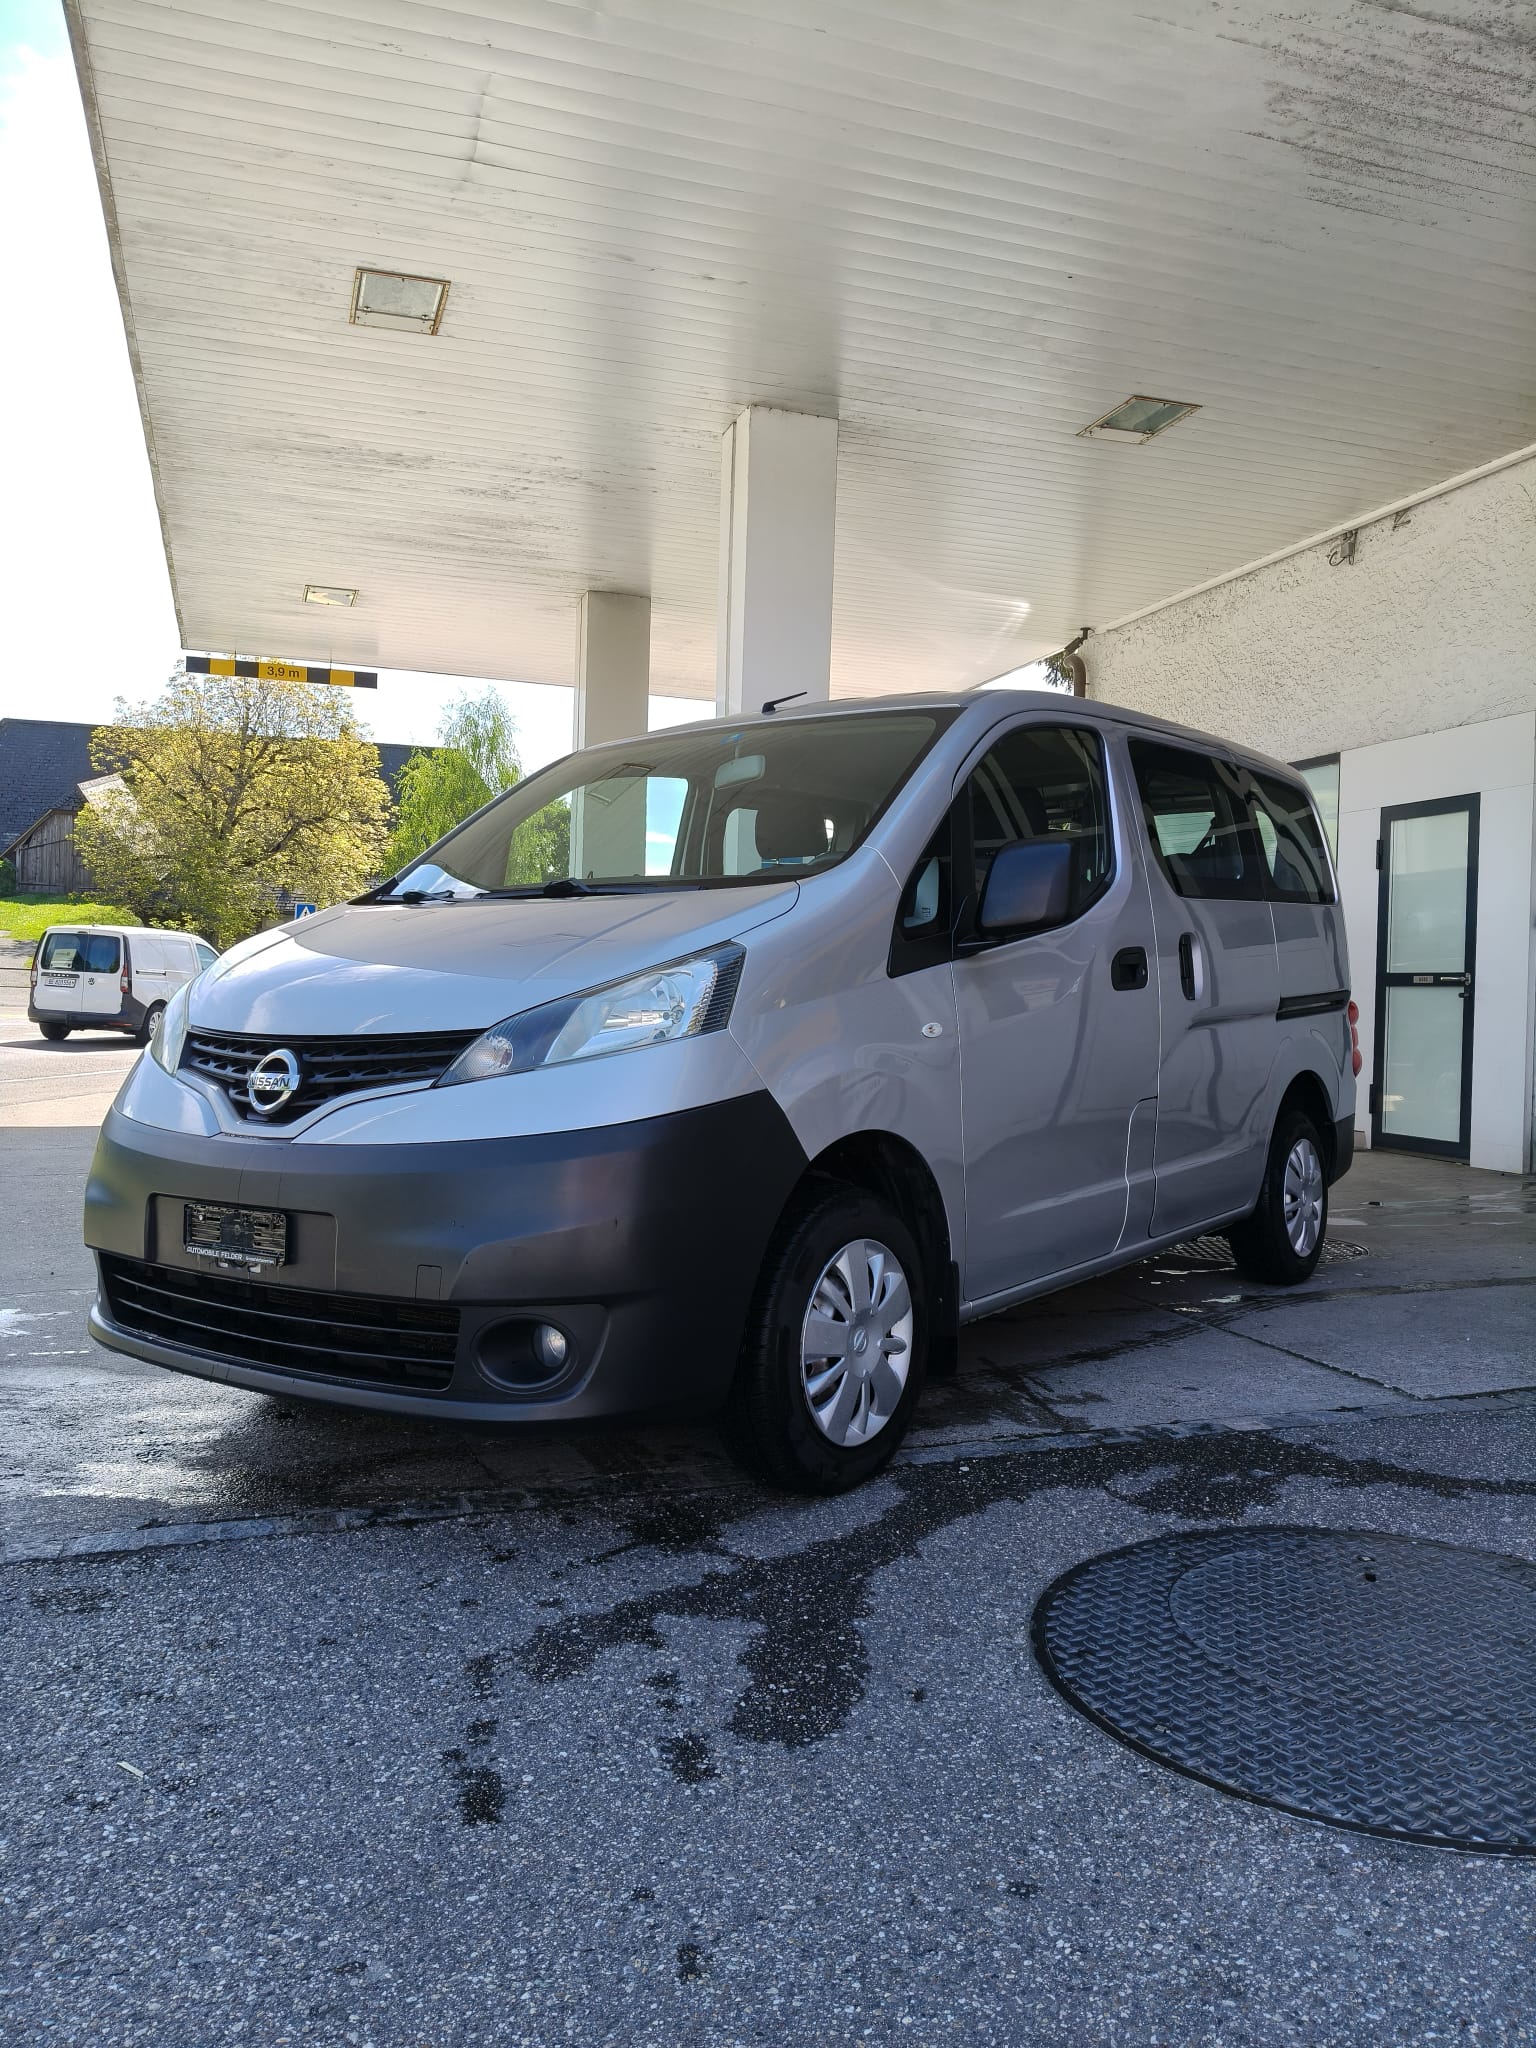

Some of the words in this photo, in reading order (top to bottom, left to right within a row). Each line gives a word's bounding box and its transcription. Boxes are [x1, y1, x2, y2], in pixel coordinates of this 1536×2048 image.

[267, 666, 285, 678] 3,9
[288, 670, 300, 678] m
[249, 1076, 291, 1089] NISSAN
[186, 1246, 220, 1258] AUTOMOBILE
[220, 1251, 243, 1261] FELDER
